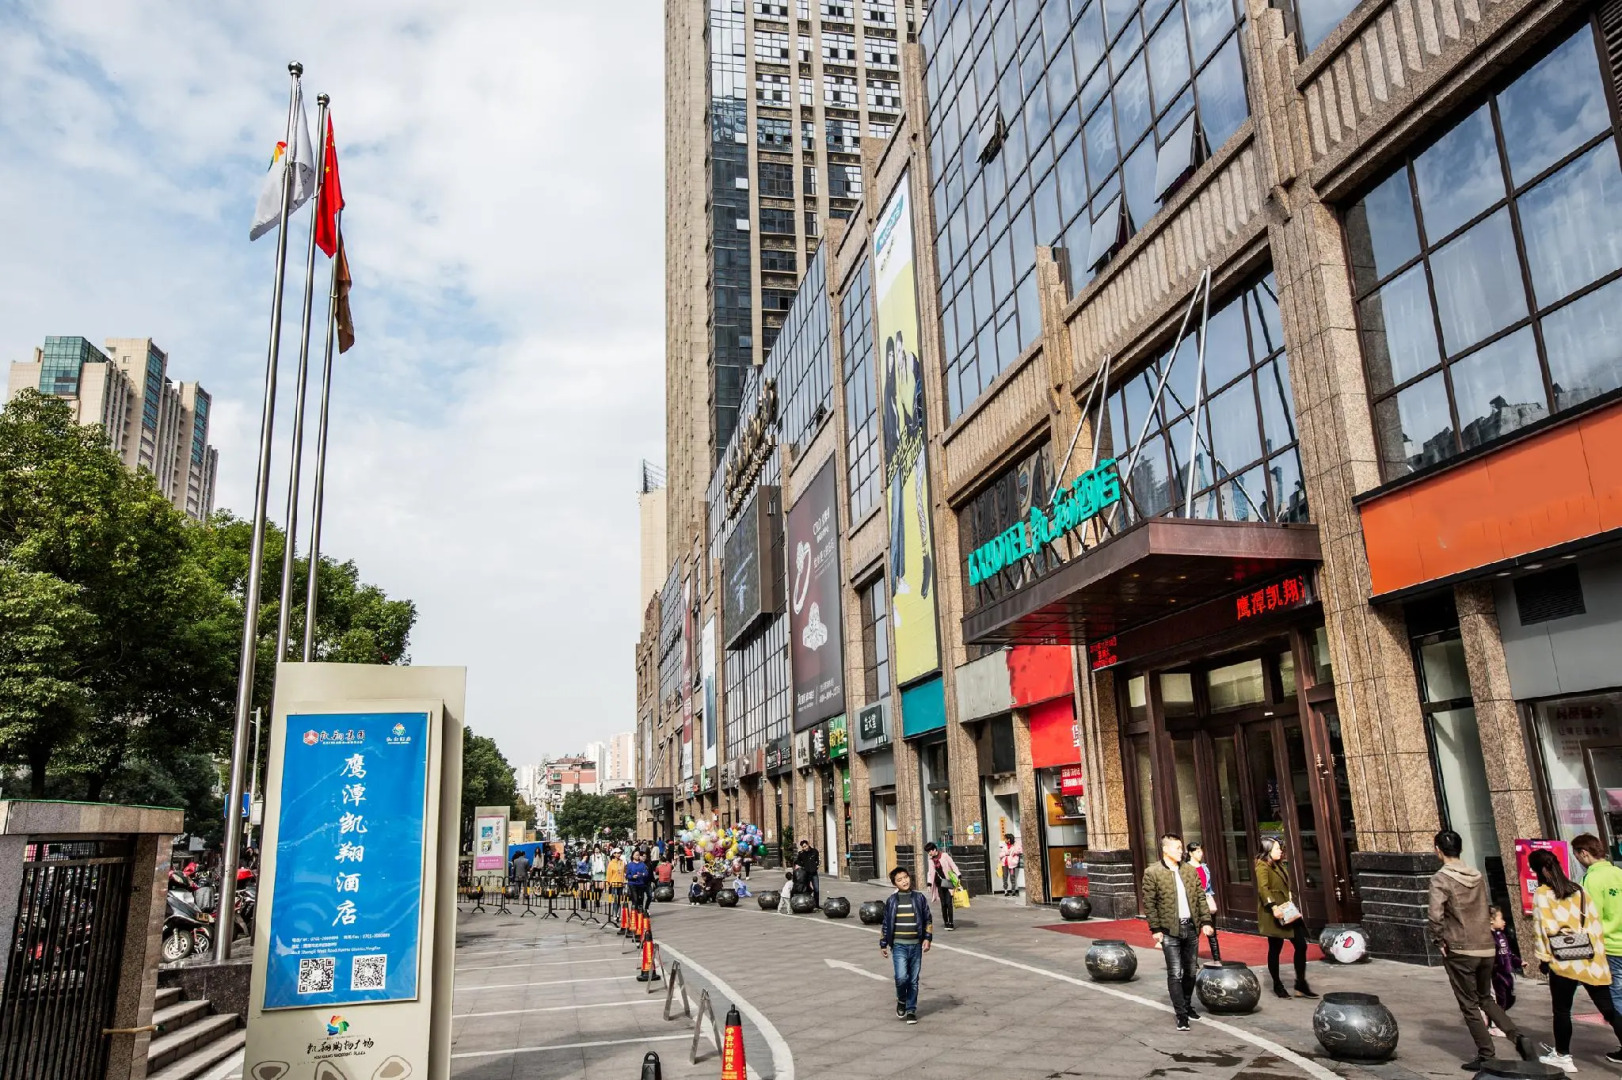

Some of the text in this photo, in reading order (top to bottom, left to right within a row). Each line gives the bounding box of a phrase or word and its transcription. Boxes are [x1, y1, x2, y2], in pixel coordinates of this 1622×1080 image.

[332, 753, 367, 927] 鹰潭凯翔酒店
